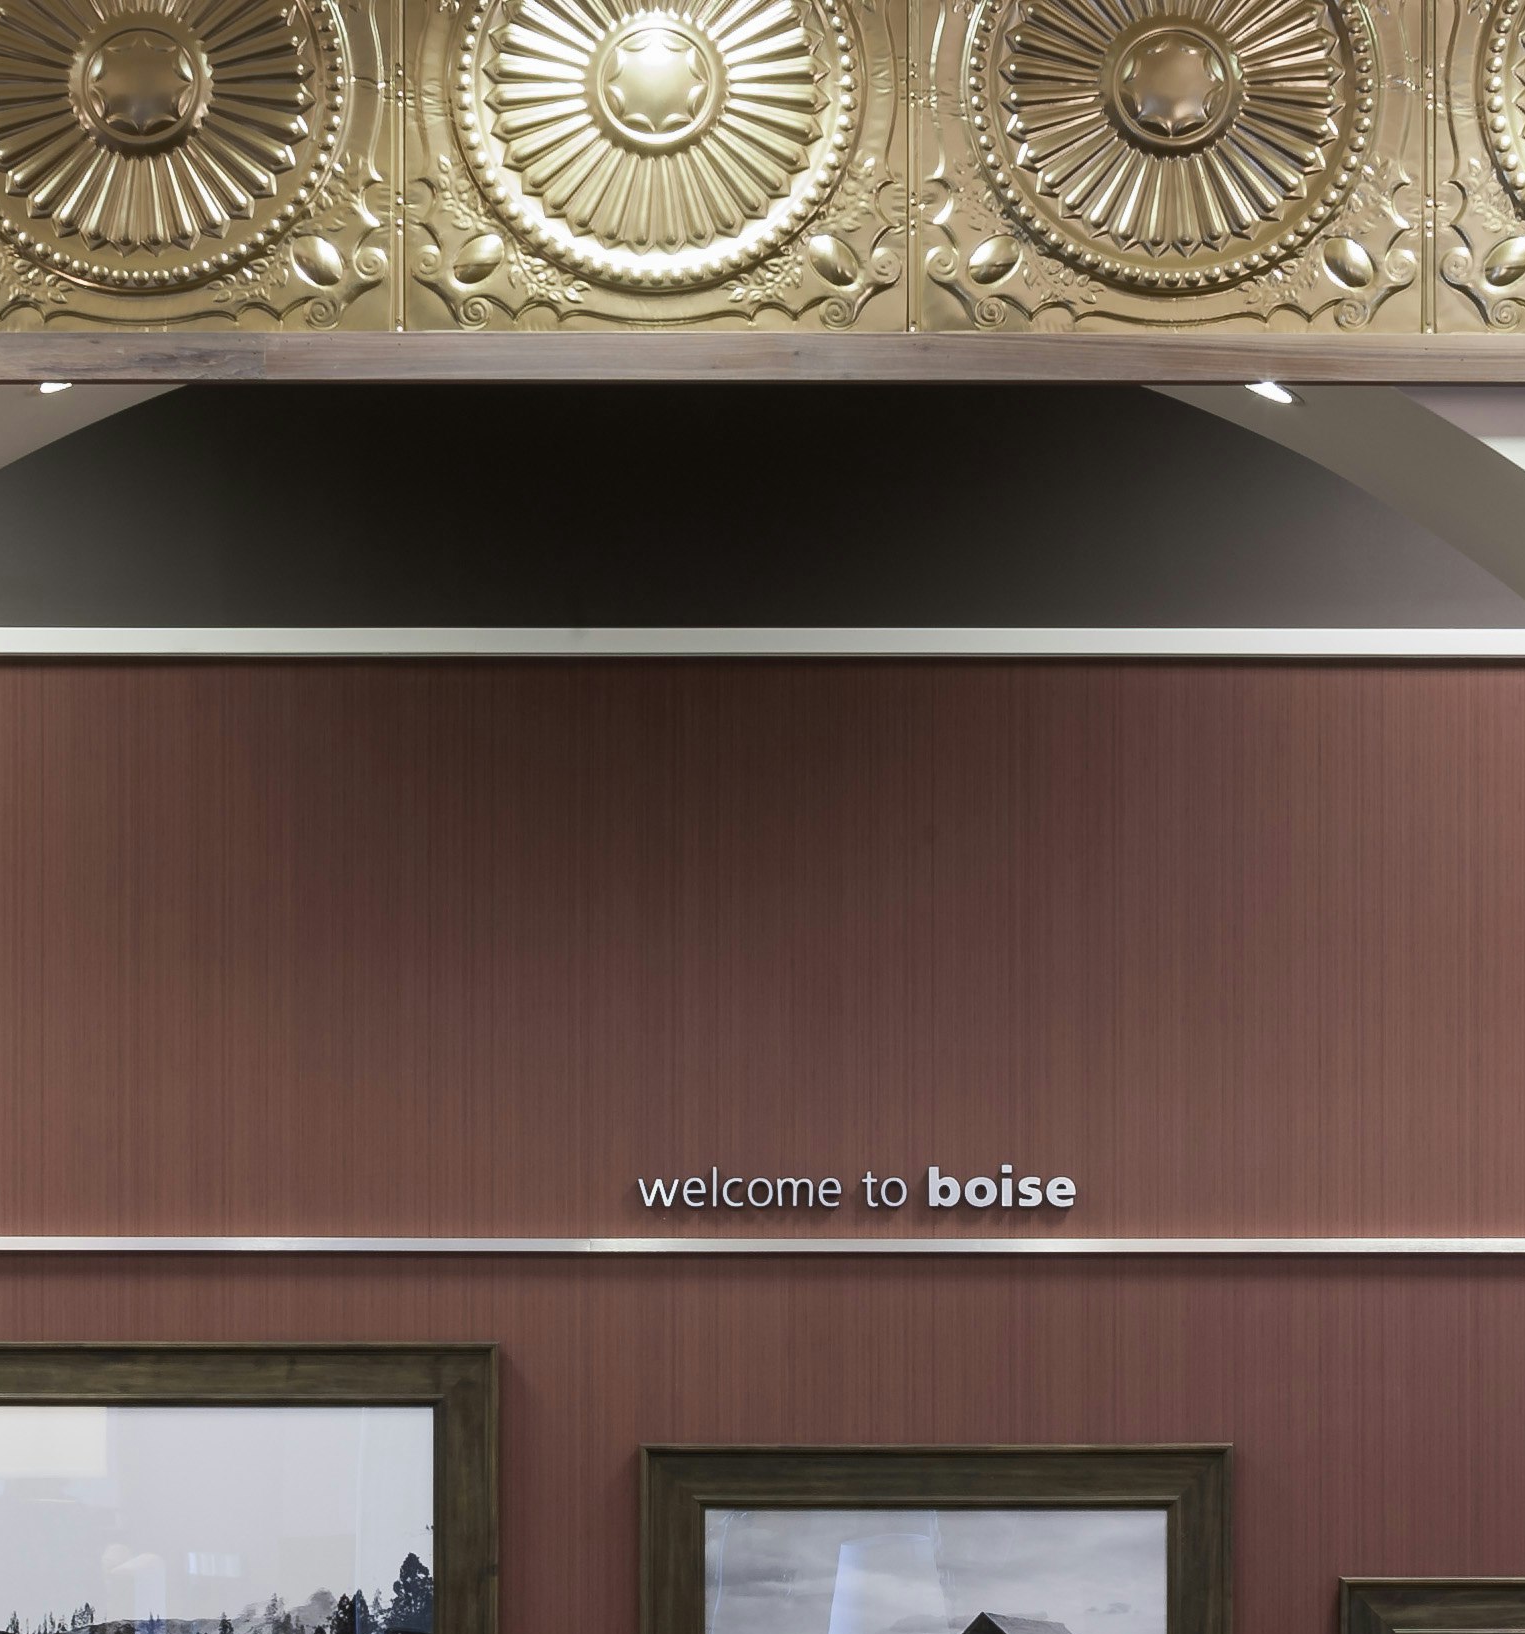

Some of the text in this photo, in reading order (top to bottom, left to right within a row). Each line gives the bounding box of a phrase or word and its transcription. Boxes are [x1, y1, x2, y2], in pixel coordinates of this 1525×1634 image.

[638, 1164, 1077, 1208] welcome to boise
